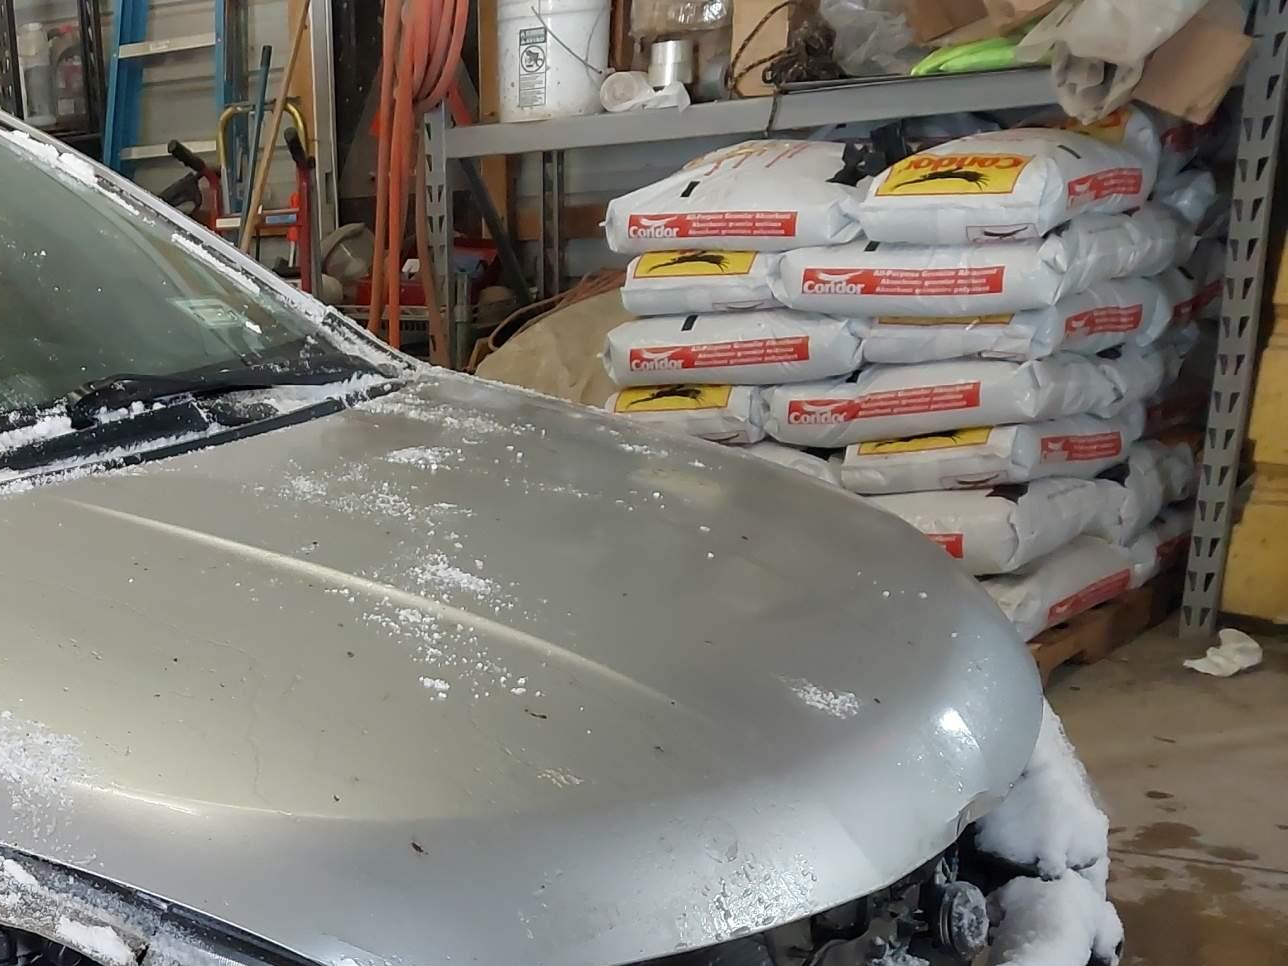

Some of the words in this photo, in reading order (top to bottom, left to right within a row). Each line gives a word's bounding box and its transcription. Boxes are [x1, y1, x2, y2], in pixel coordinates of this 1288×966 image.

[629, 225, 680, 238] Condor
[802, 280, 865, 295] Condor
[631, 358, 685, 372] Condor
